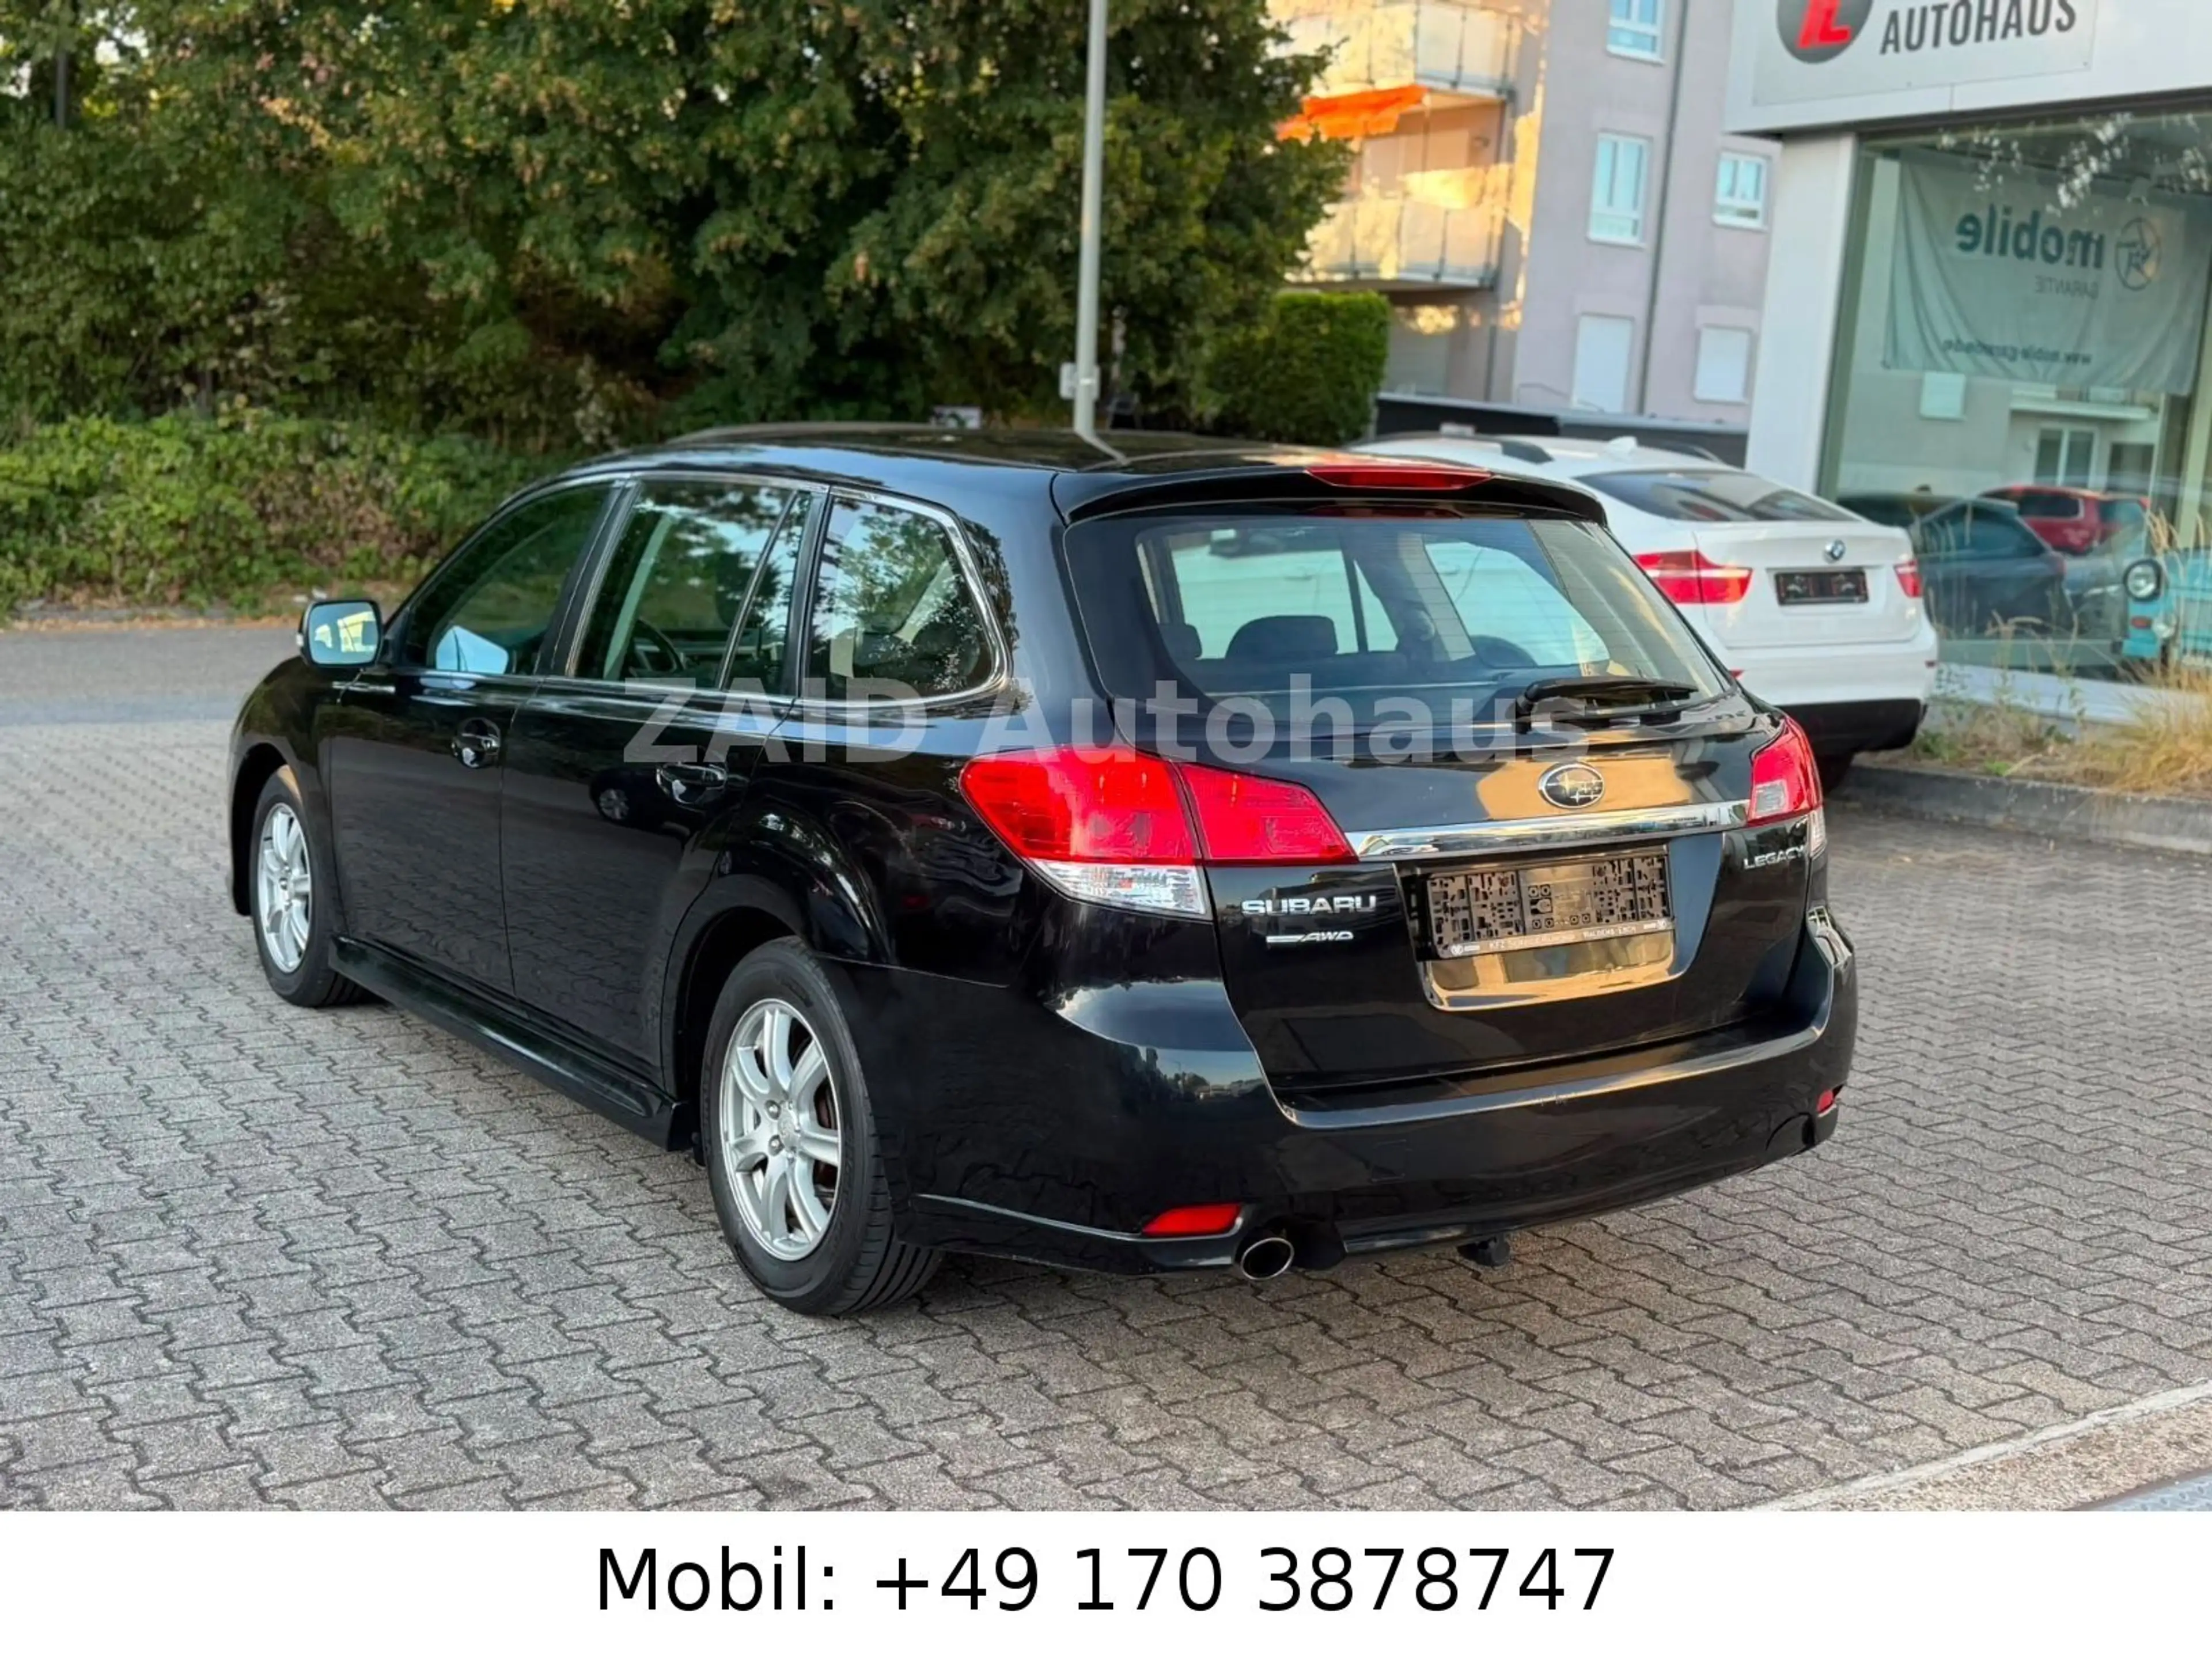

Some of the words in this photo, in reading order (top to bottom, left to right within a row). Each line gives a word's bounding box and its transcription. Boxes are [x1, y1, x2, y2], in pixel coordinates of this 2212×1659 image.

[1879, 0, 2076, 55] AUTOHAUS
[1743, 844, 1805, 870] LEGACY
[1241, 895, 1377, 916] SUBARU
[1301, 931, 1354, 942] AWD
